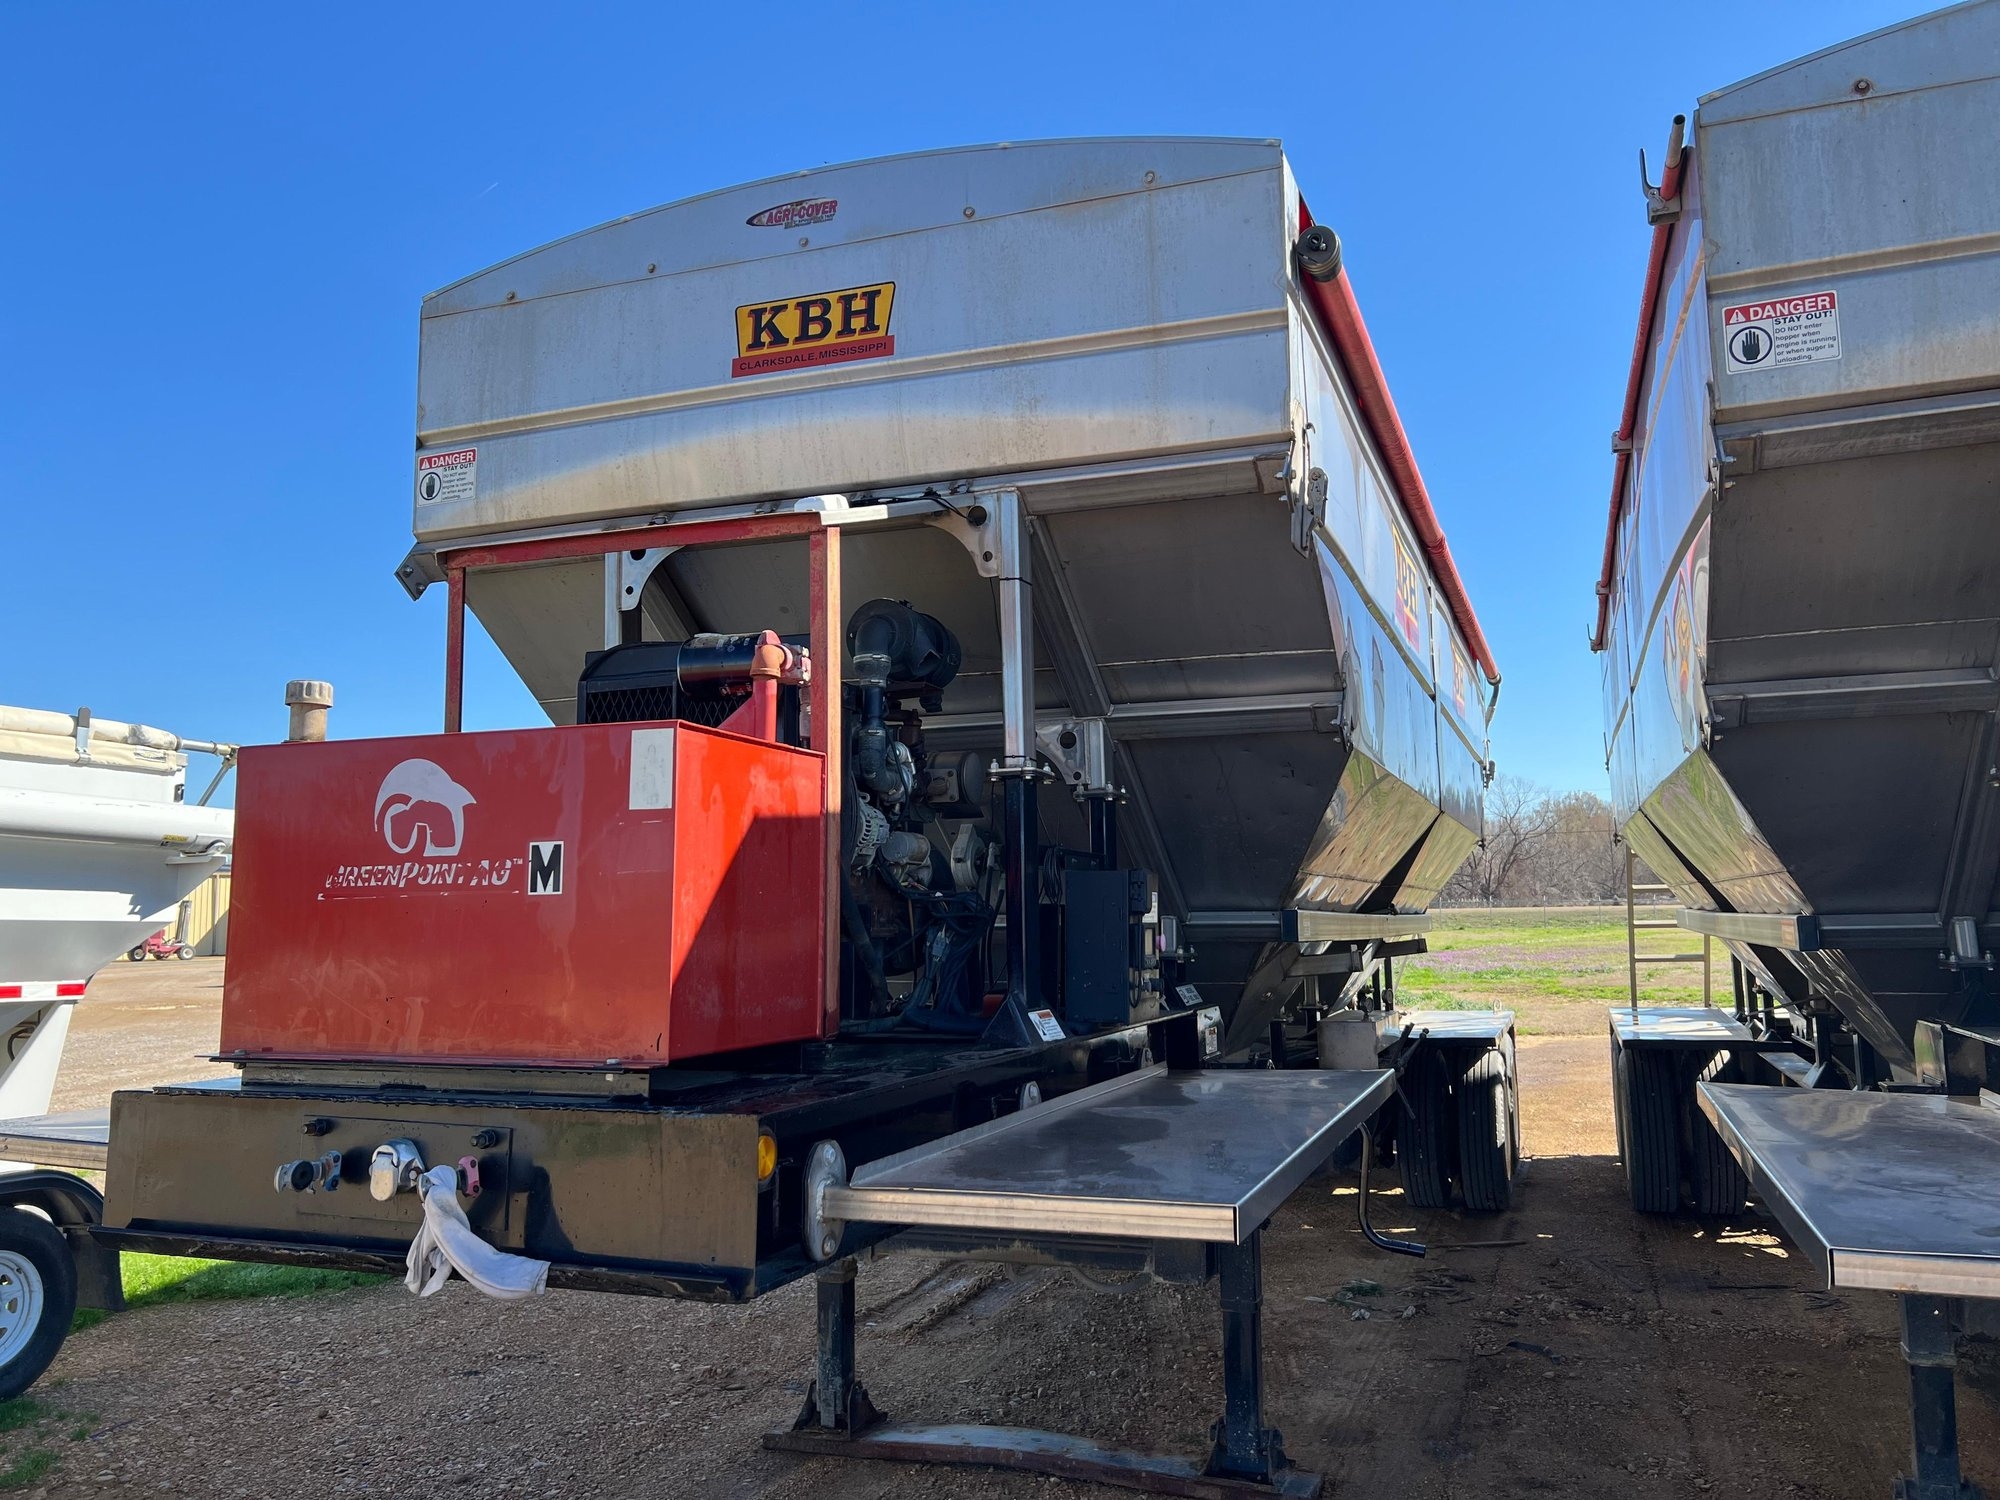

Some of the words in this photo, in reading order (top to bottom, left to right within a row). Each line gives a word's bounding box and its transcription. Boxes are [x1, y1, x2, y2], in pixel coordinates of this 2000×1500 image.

[766, 200, 838, 225] AGRI-COVER
[1749, 296, 1831, 321] DANGER
[746, 289, 882, 353] KBH
[1774, 315, 1802, 325] STAY
[1806, 310, 1833, 320] OUT!
[1804, 322, 1823, 330] enter
[1775, 334, 1800, 342] hopper
[1801, 330, 1821, 338] when
[1776, 341, 1800, 350] engine
[1809, 335, 1837, 345] running
[819, 342, 887, 360] MISSISSIPPI
[1785, 347, 1804, 355] when
[1806, 345, 1826, 354] auger
[1777, 354, 1812, 364] unloading
[431, 451, 474, 468] DANGER
[530, 843, 562, 893] M
